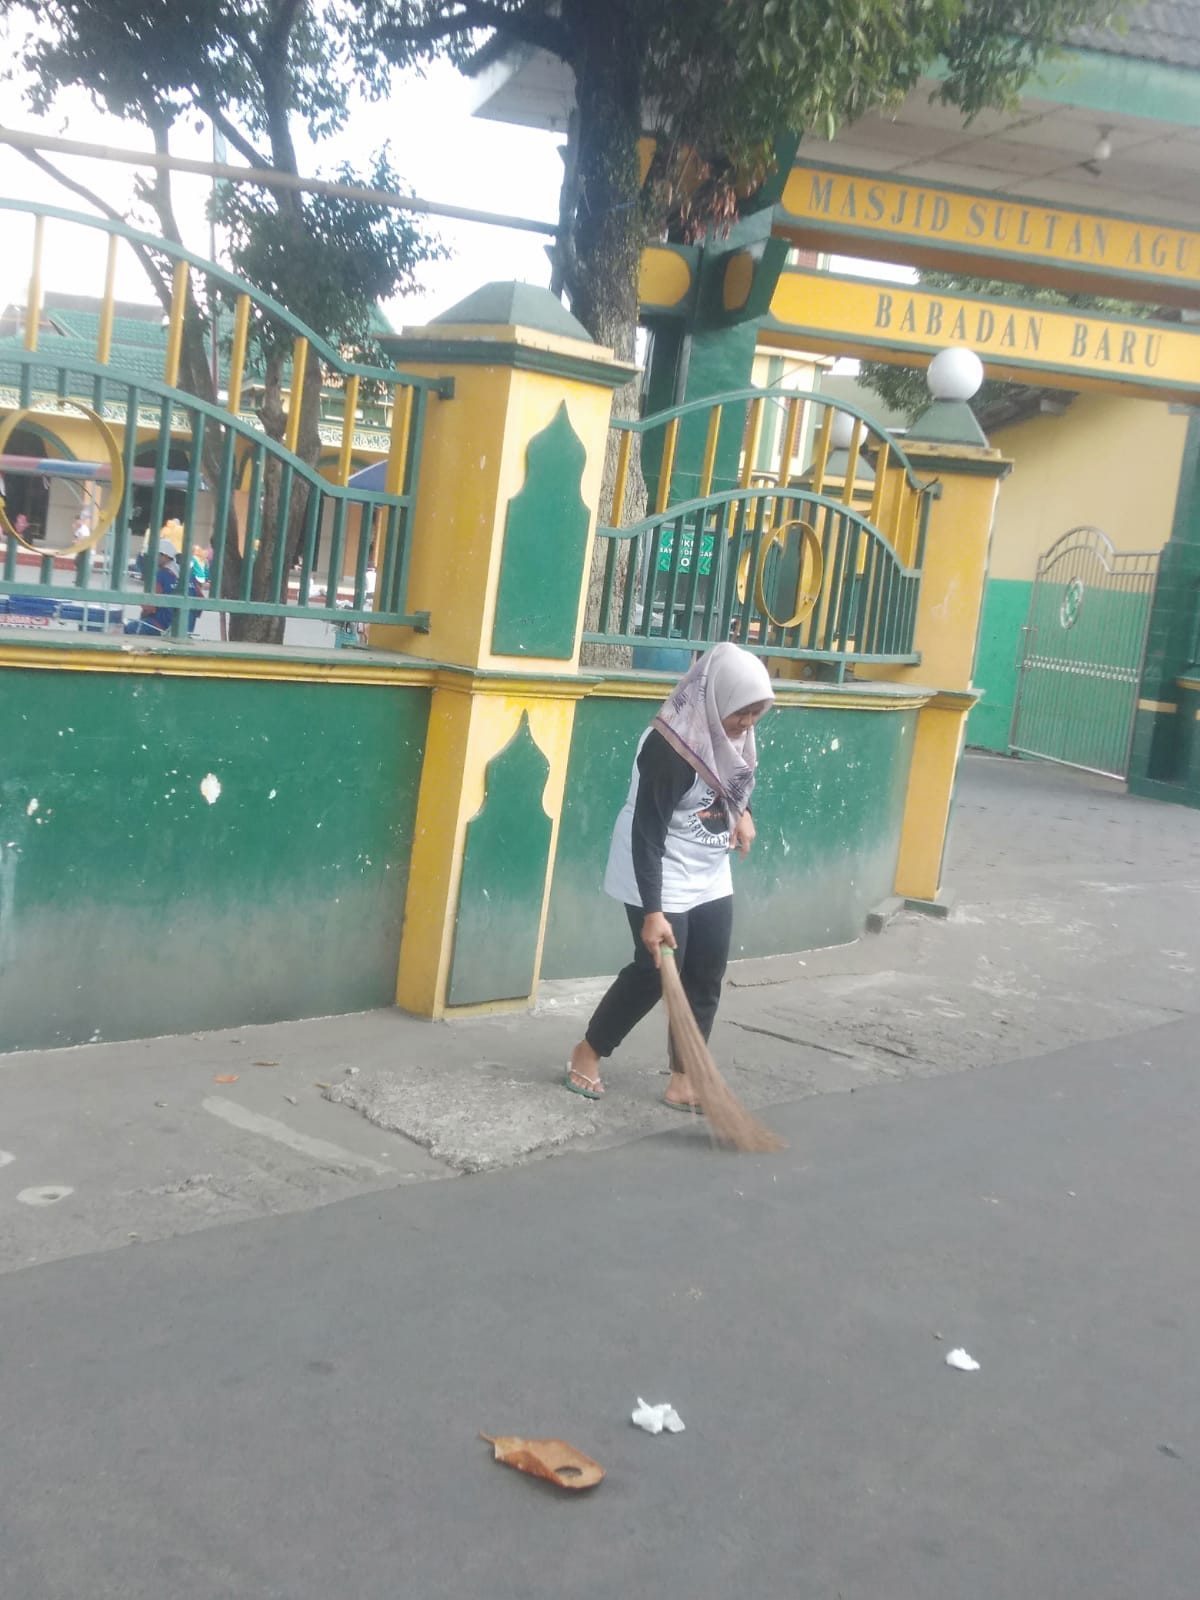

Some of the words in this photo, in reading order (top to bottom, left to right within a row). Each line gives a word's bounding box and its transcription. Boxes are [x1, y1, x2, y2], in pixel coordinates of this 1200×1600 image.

[808, 175, 950, 231] MASJID
[965, 201, 1112, 258] SULTAN
[1126, 230, 1200, 275] AGU
[875, 293, 1043, 351] BABADAN
[1070, 322, 1163, 368] BARU
